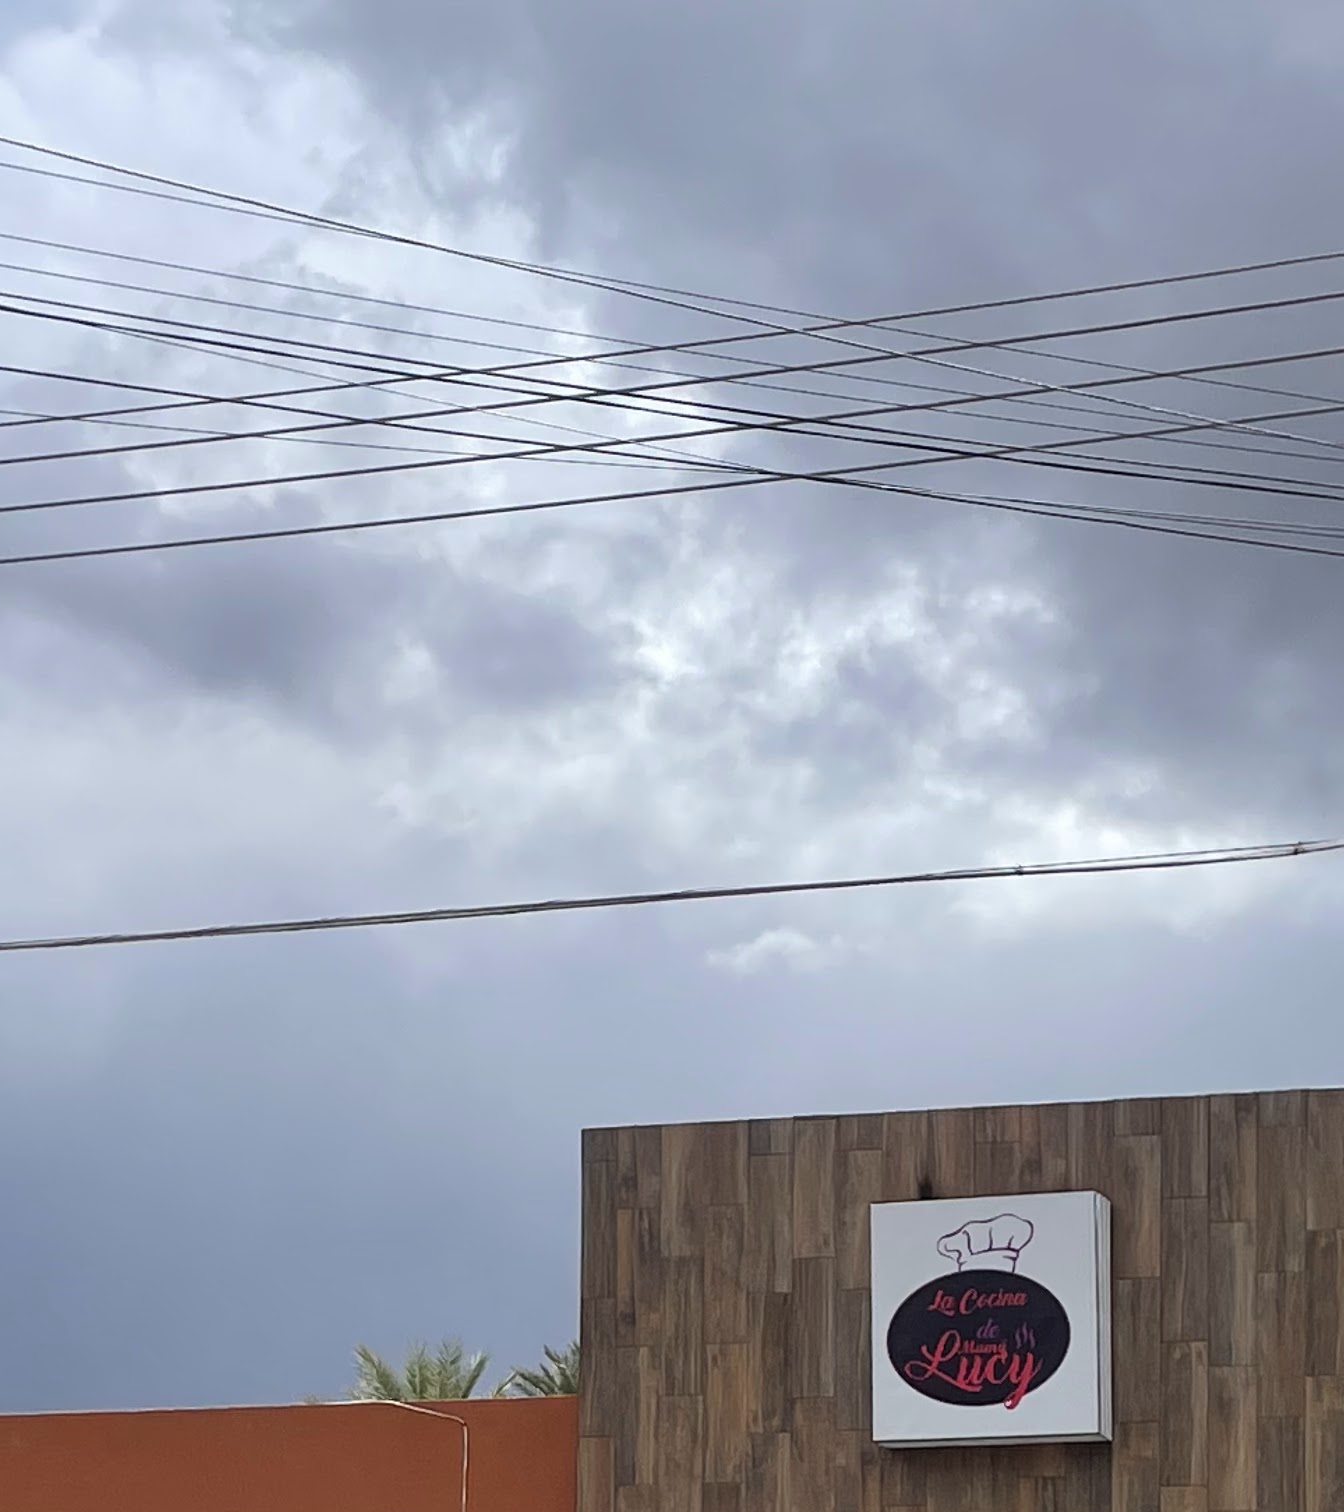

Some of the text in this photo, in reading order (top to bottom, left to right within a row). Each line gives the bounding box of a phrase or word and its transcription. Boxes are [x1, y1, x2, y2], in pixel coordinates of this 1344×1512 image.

[927, 1287, 1029, 1317] La Cocina
[976, 1317, 999, 1338] de
[904, 1329, 1044, 1410] Lucy
